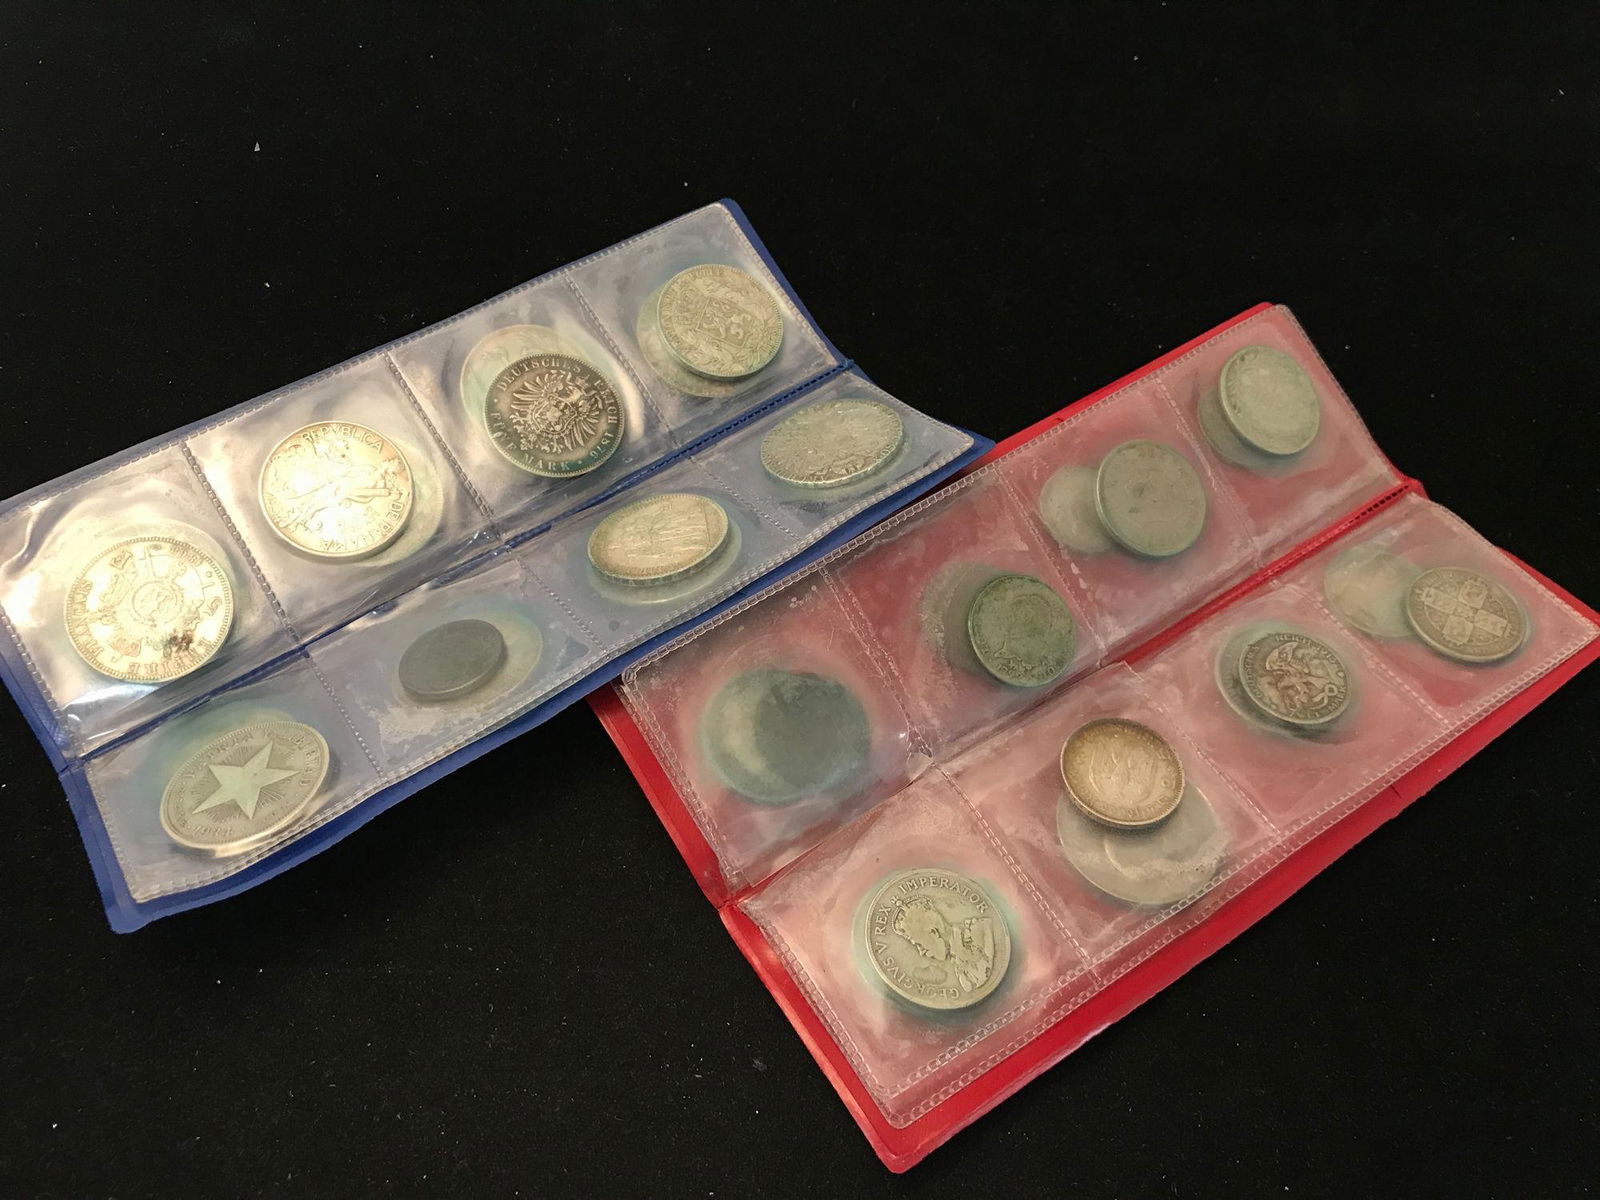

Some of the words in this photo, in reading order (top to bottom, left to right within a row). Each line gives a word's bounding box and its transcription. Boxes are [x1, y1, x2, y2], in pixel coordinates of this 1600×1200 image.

[496, 358, 581, 391] DEUTSCHES
[301, 425, 384, 454] REPVBLICA
[523, 453, 570, 471] MARK
[899, 876, 989, 914] IMPERATOR
[874, 903, 891, 936] REX
[875, 941, 888, 954] V
